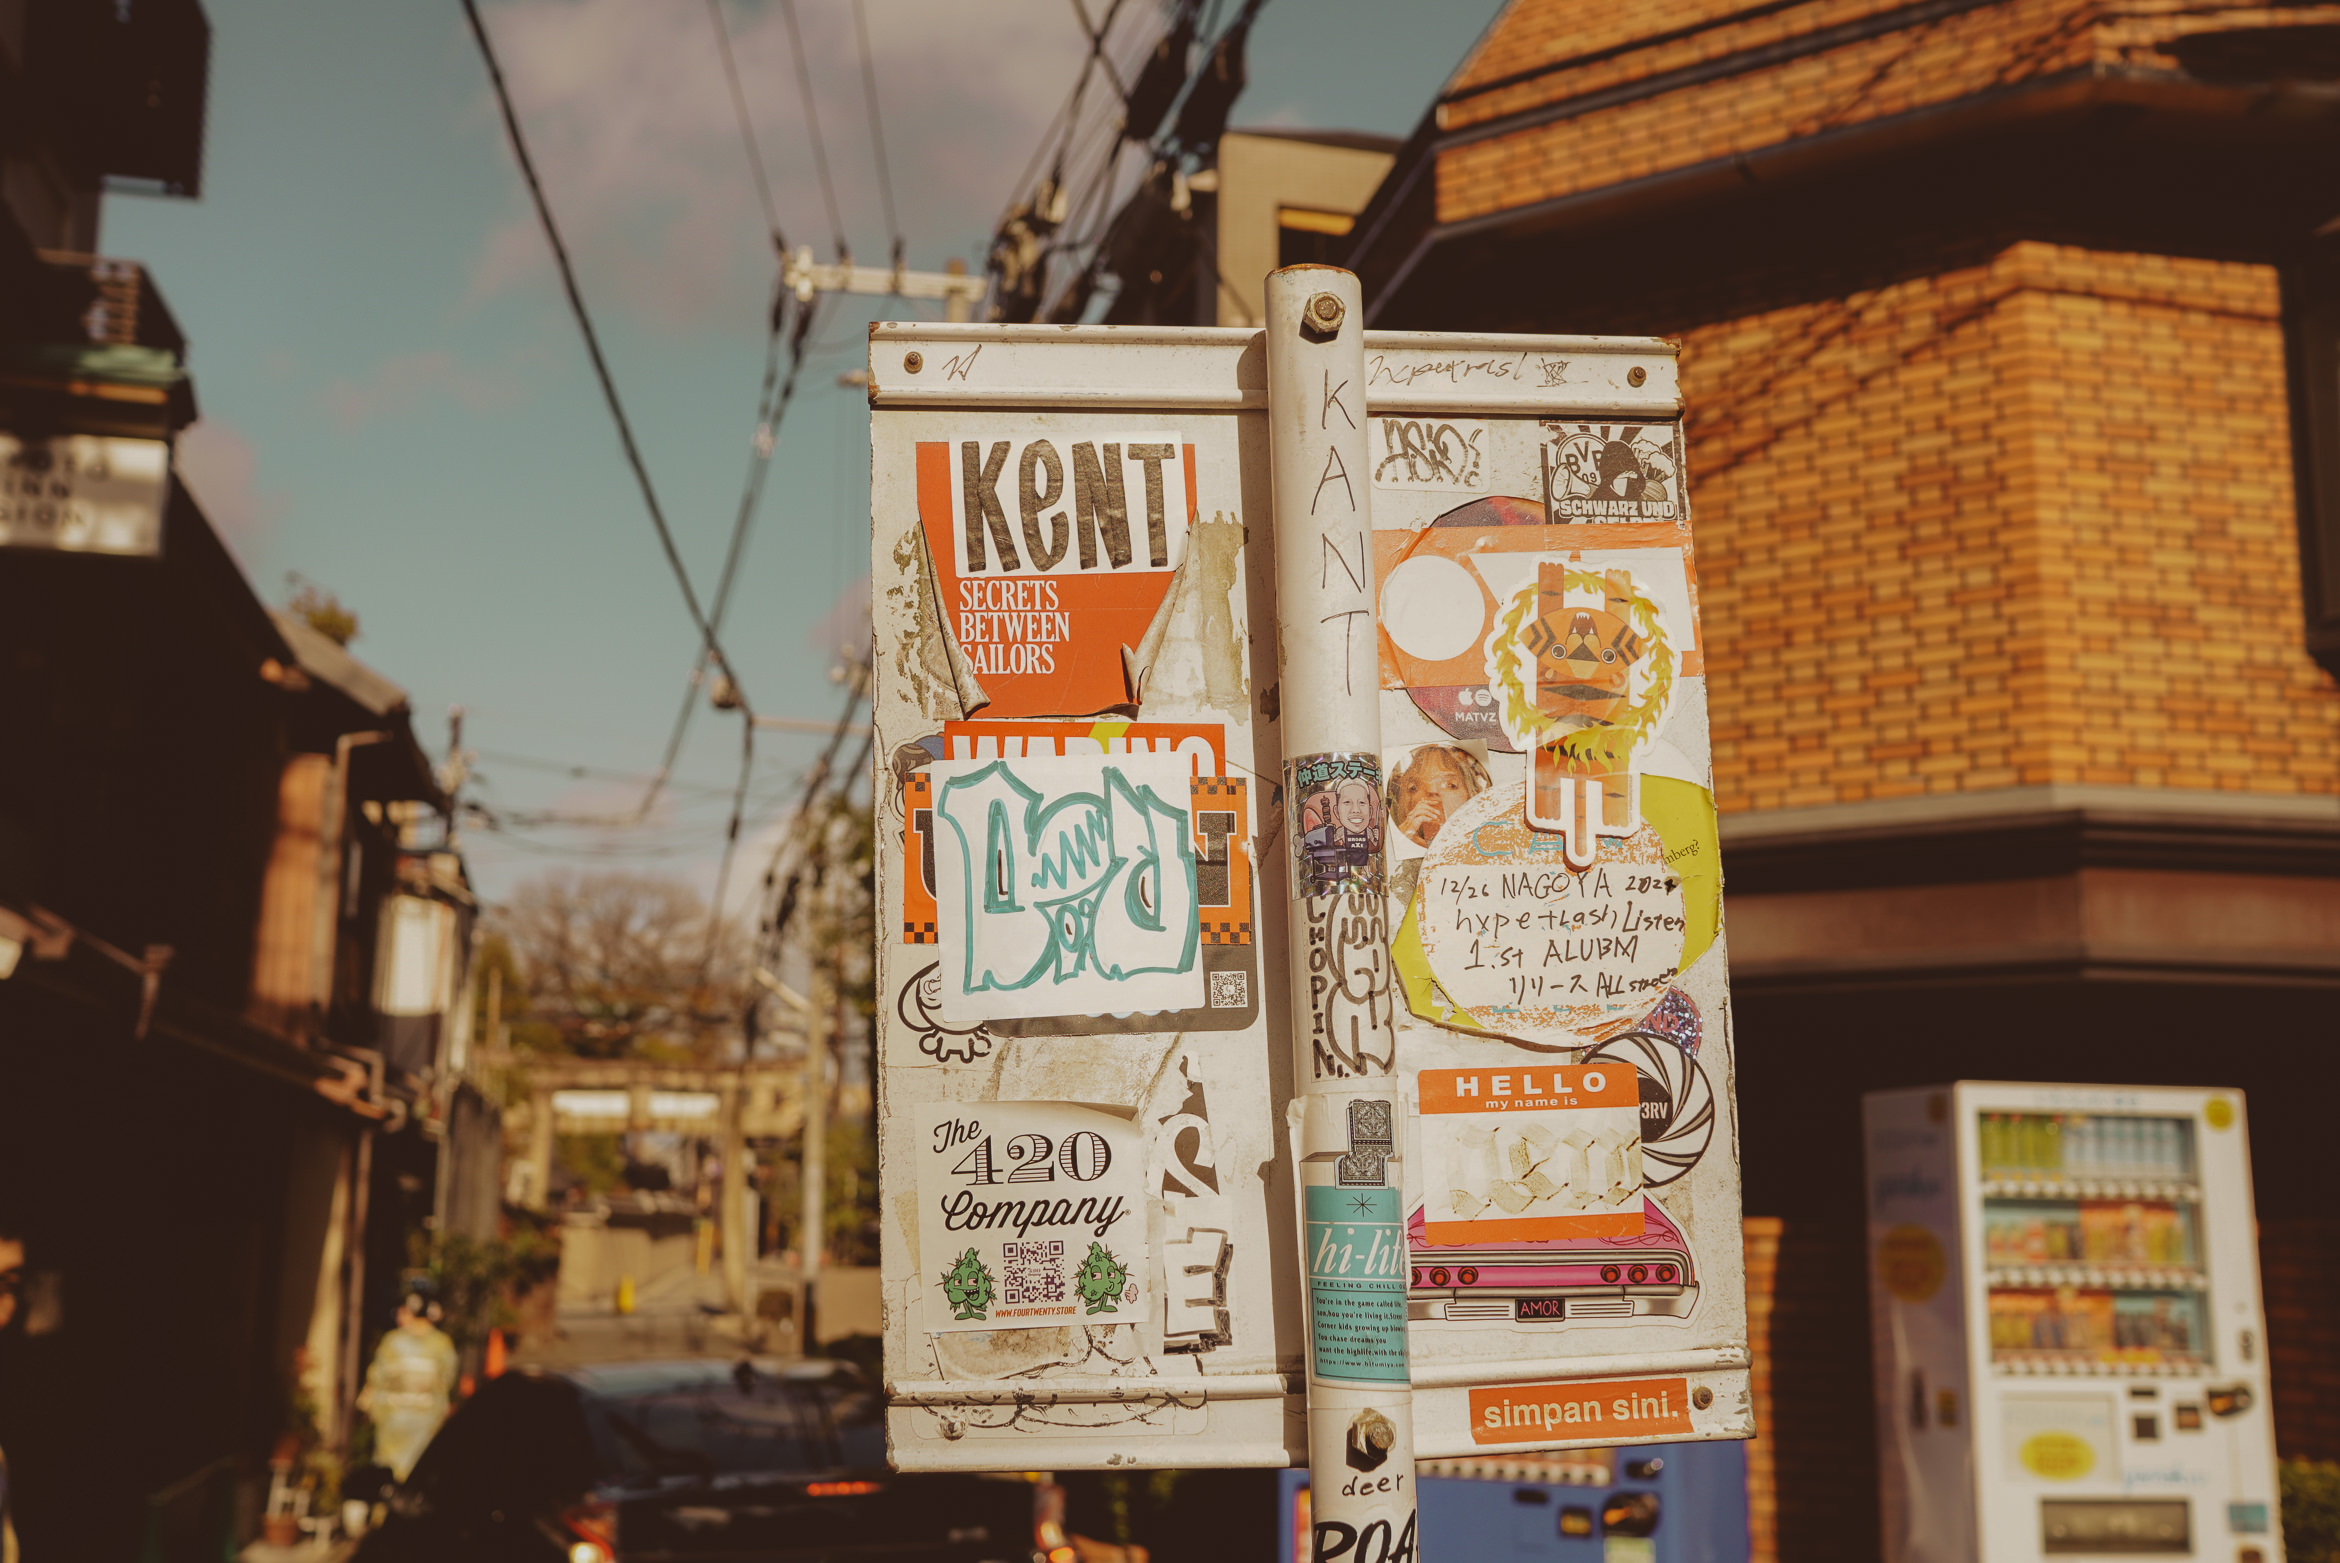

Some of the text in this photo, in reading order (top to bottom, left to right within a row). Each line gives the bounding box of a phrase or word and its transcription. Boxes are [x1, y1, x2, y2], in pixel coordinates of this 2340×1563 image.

[1560, 500, 1675, 518] SCHWARZ UND
[959, 580, 1060, 612] SECRETS
[959, 612, 1070, 643] BETWEEN
[960, 644, 1056, 675] SAILORS
[1455, 711, 1497, 722] MATVZ
[1441, 875, 1490, 904] 12/26
[1502, 867, 1613, 899] NAGOYA
[1455, 1071, 1607, 1098] HELLO
[1485, 1095, 1578, 1111] my name is
[1639, 1101, 1668, 1120] 3RV
[933, 1117, 982, 1153] The
[951, 1131, 1112, 1187] 420
[941, 1190, 1125, 1239] Company
[995, 1306, 1077, 1318] WWW.FOURTWENTY.STORE
[1344, 1298, 1355, 1306] the
[1357, 1300, 1375, 1309] game
[1520, 1300, 1560, 1316] AMOR
[1317, 1321, 1336, 1329] Corner
[1338, 1322, 1352, 1331] kids
[1329, 1334, 1348, 1343] chase
[1349, 1335, 1374, 1344] dreams
[1375, 1337, 1387, 1345] you
[1484, 1391, 1679, 1431] simpan sini.
[1341, 1473, 1404, 1496] deer
